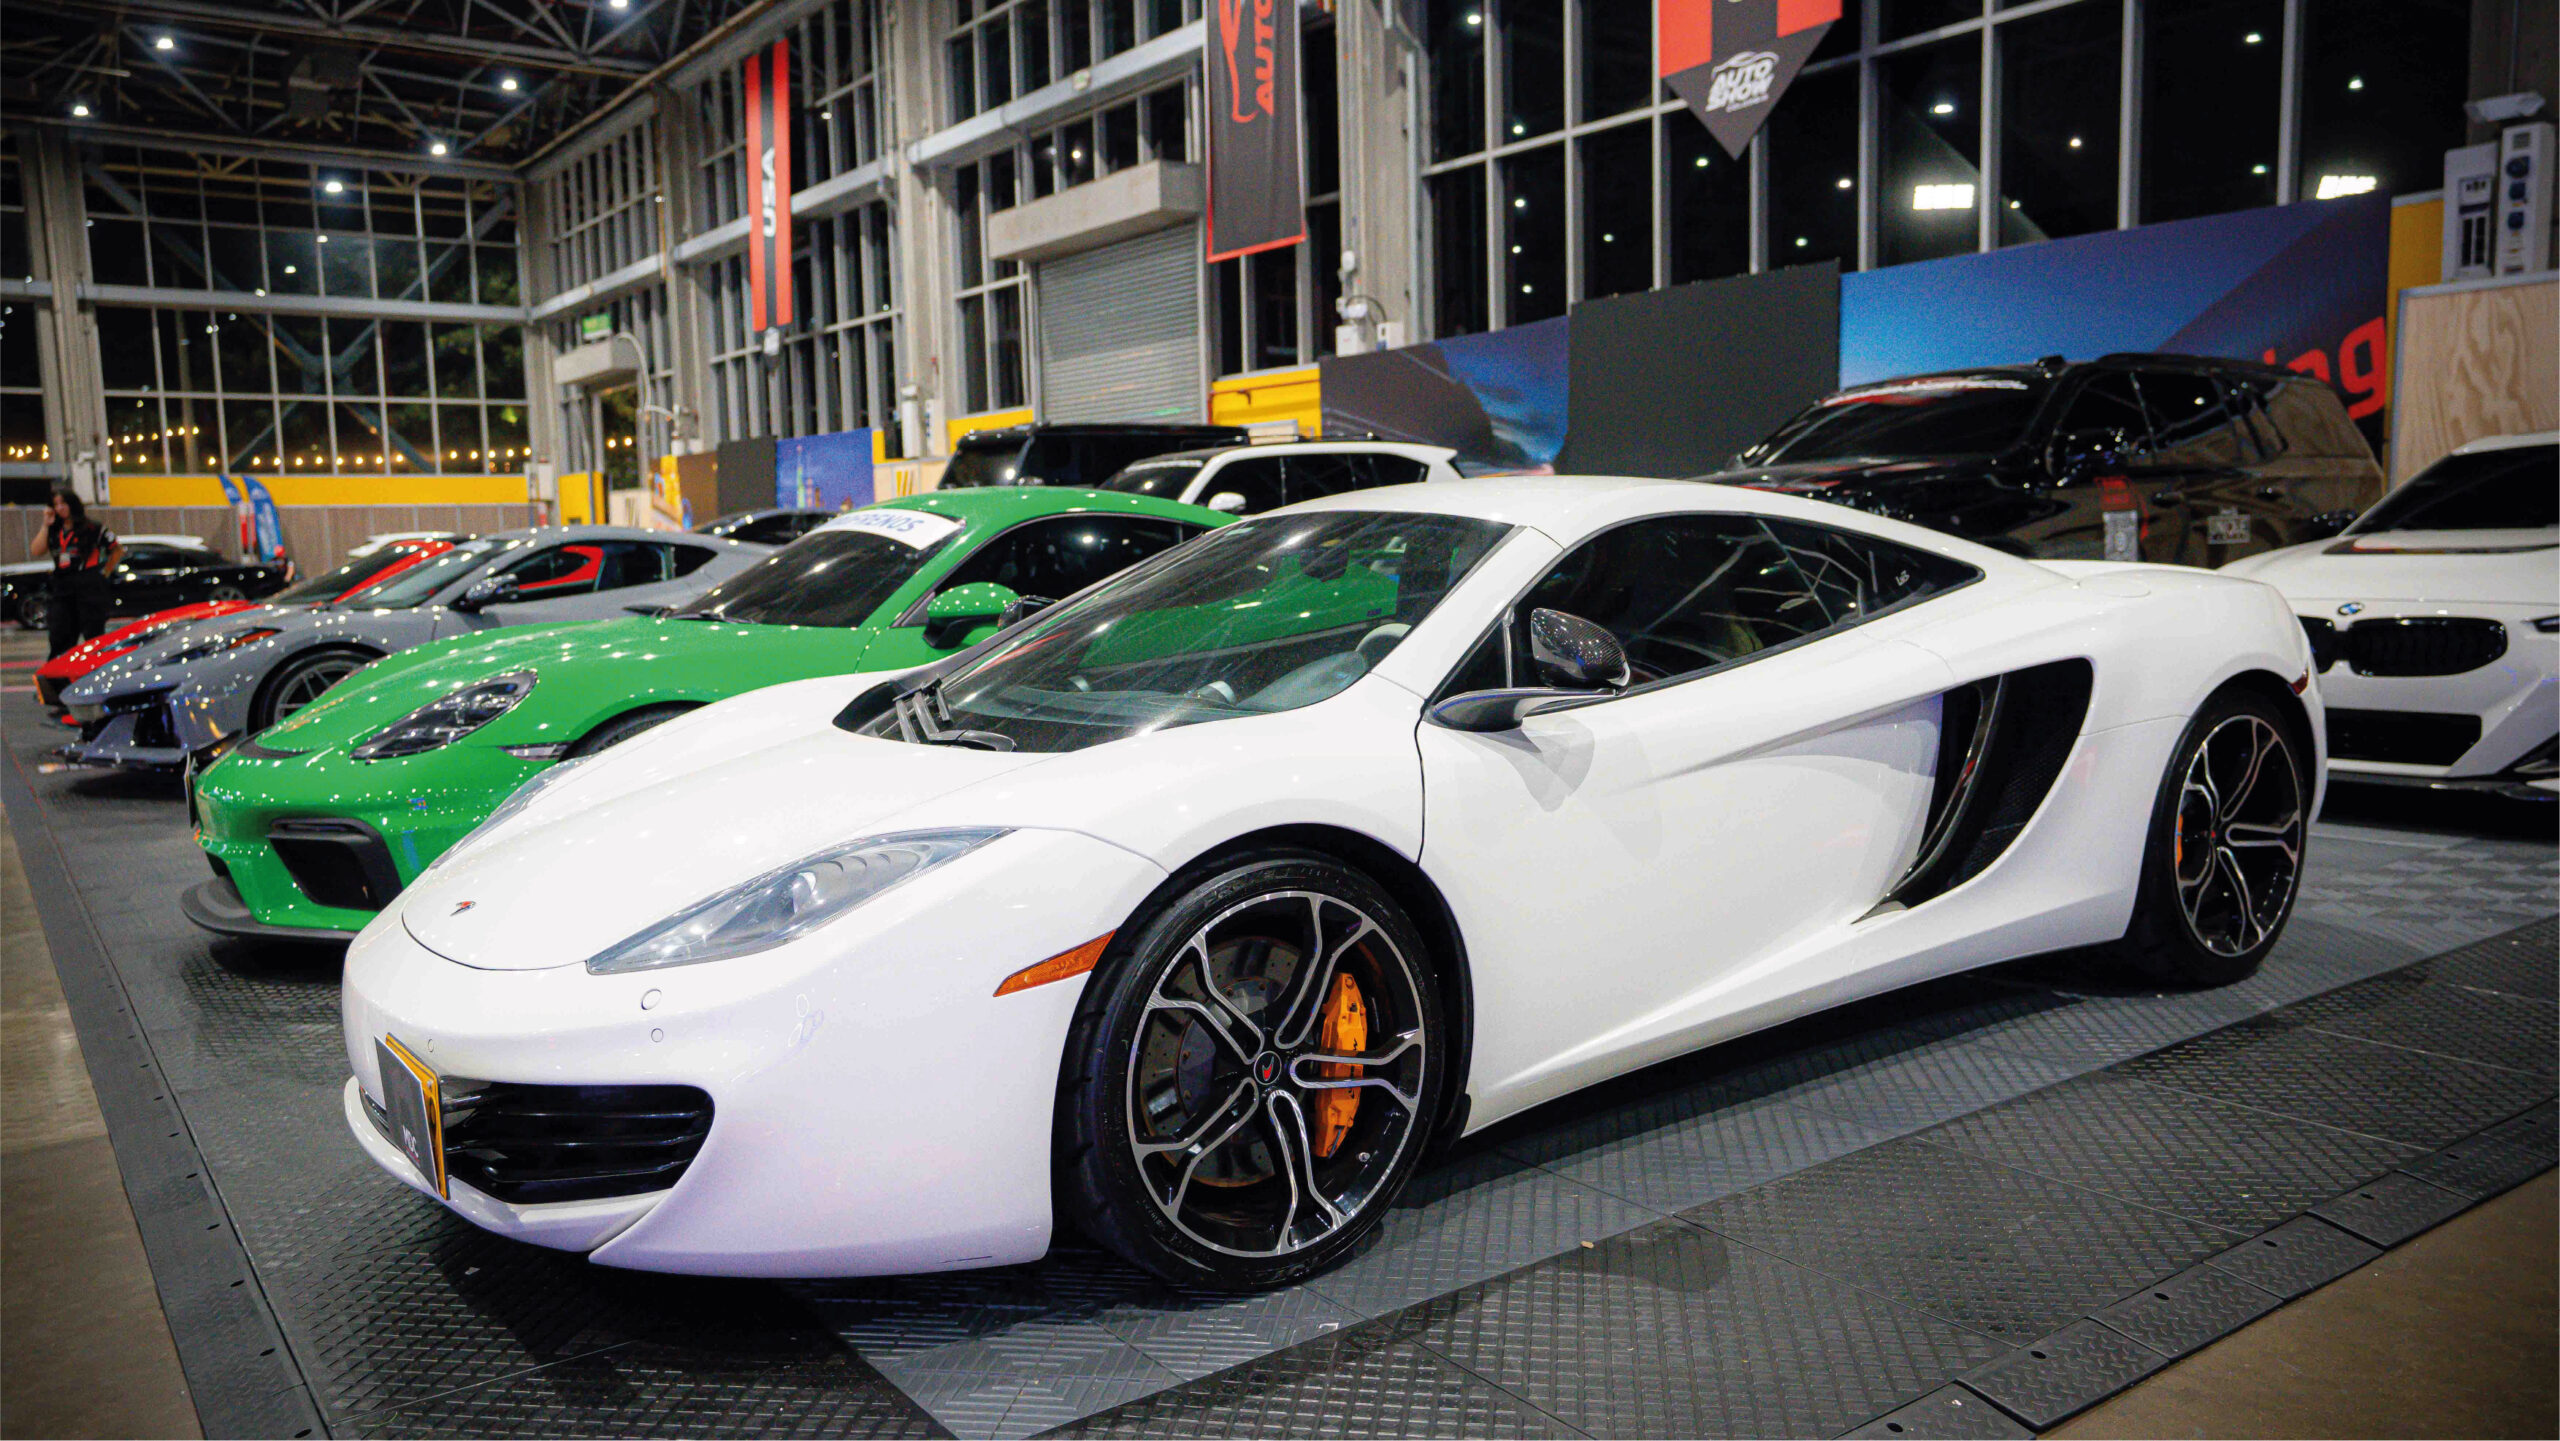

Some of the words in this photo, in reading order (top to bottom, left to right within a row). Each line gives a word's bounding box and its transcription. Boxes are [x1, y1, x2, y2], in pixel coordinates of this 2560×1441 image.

[1705, 75, 1775, 112] SHOW
[1712, 59, 1773, 95] AUTO
[761, 147, 776, 237] USA
